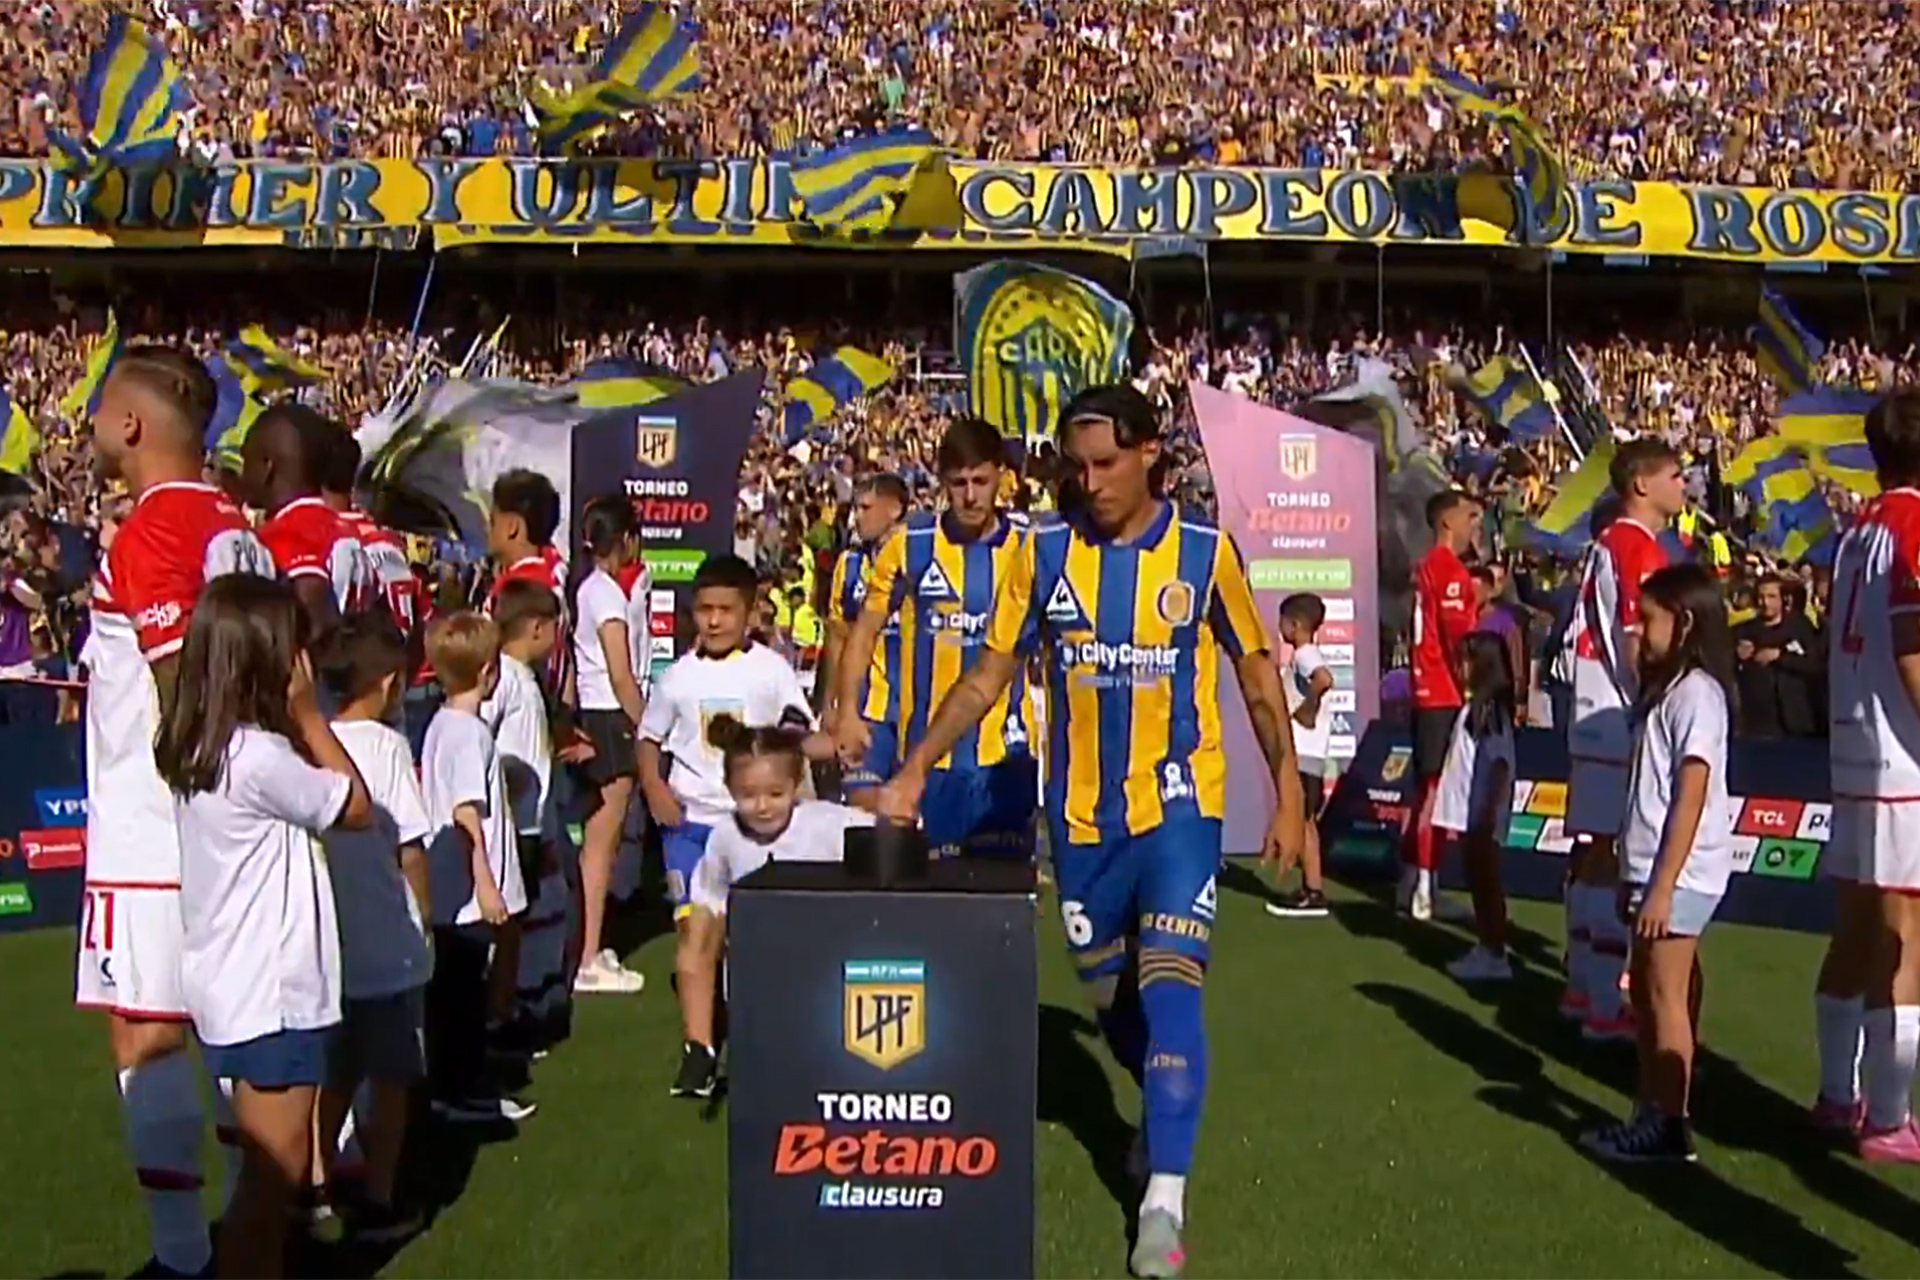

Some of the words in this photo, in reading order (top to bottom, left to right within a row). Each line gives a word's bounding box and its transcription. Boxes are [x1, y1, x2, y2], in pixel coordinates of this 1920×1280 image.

[412, 160, 482, 223] Y
[624, 480, 688, 496] TORNEO
[1267, 492, 1331, 508] TORNEO
[1752, 809, 1786, 827] TCL
[1062, 901, 1093, 946] 6
[856, 994, 914, 1054] LPF
[817, 1093, 952, 1121] TORNEO
[774, 1124, 997, 1175] Betano
[824, 1180, 943, 1207] clausura
